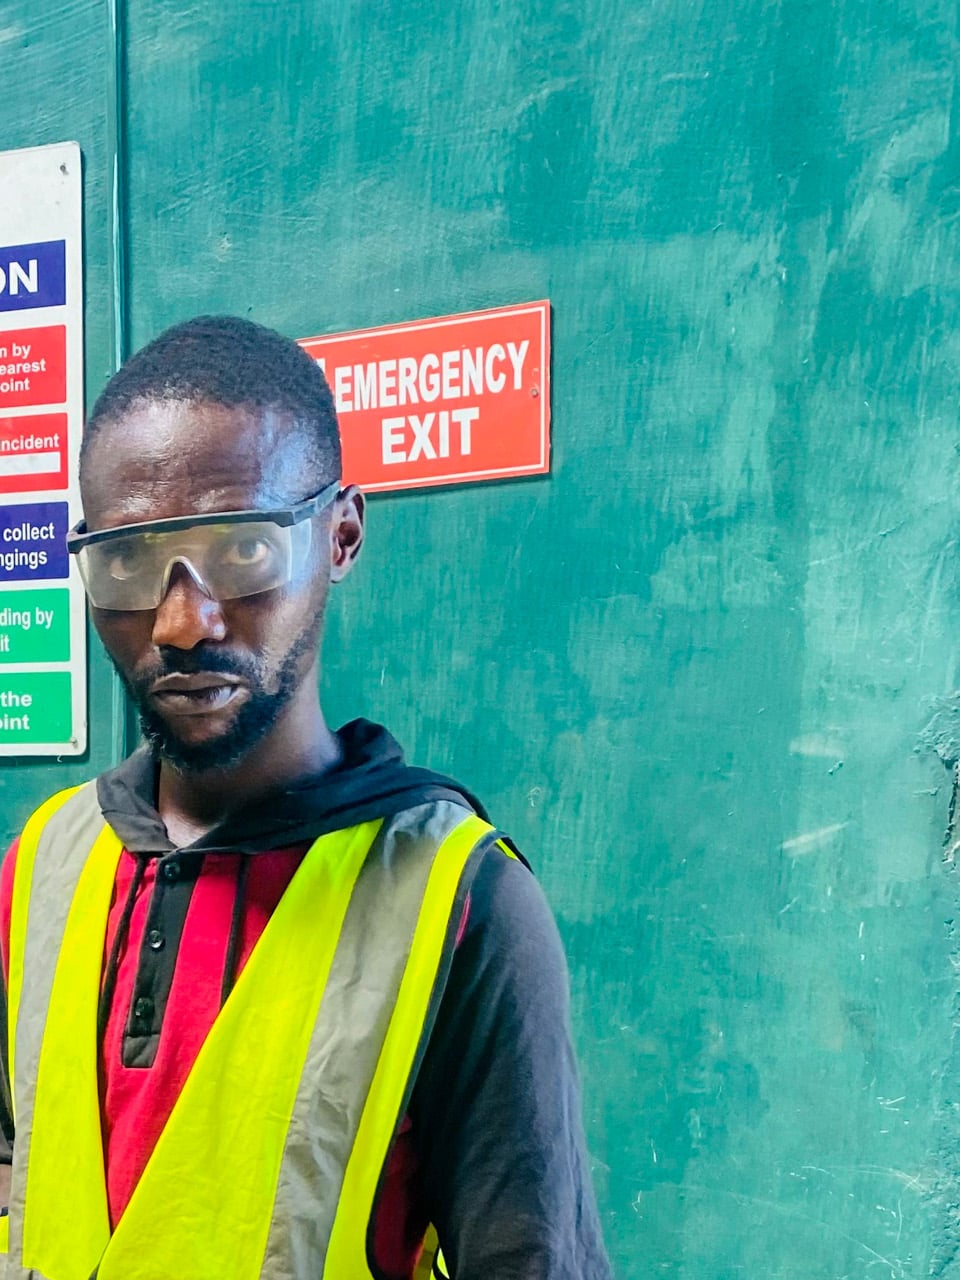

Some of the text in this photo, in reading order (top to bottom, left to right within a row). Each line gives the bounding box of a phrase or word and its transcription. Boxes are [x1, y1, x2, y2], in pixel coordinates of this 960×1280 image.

[12, 343, 31, 359] by
[334, 340, 529, 413] EMERGENCY
[381, 407, 480, 465] EXIT
[3, 523, 55, 542] collect
[35, 607, 54, 629] by
[0, 691, 32, 708] the
